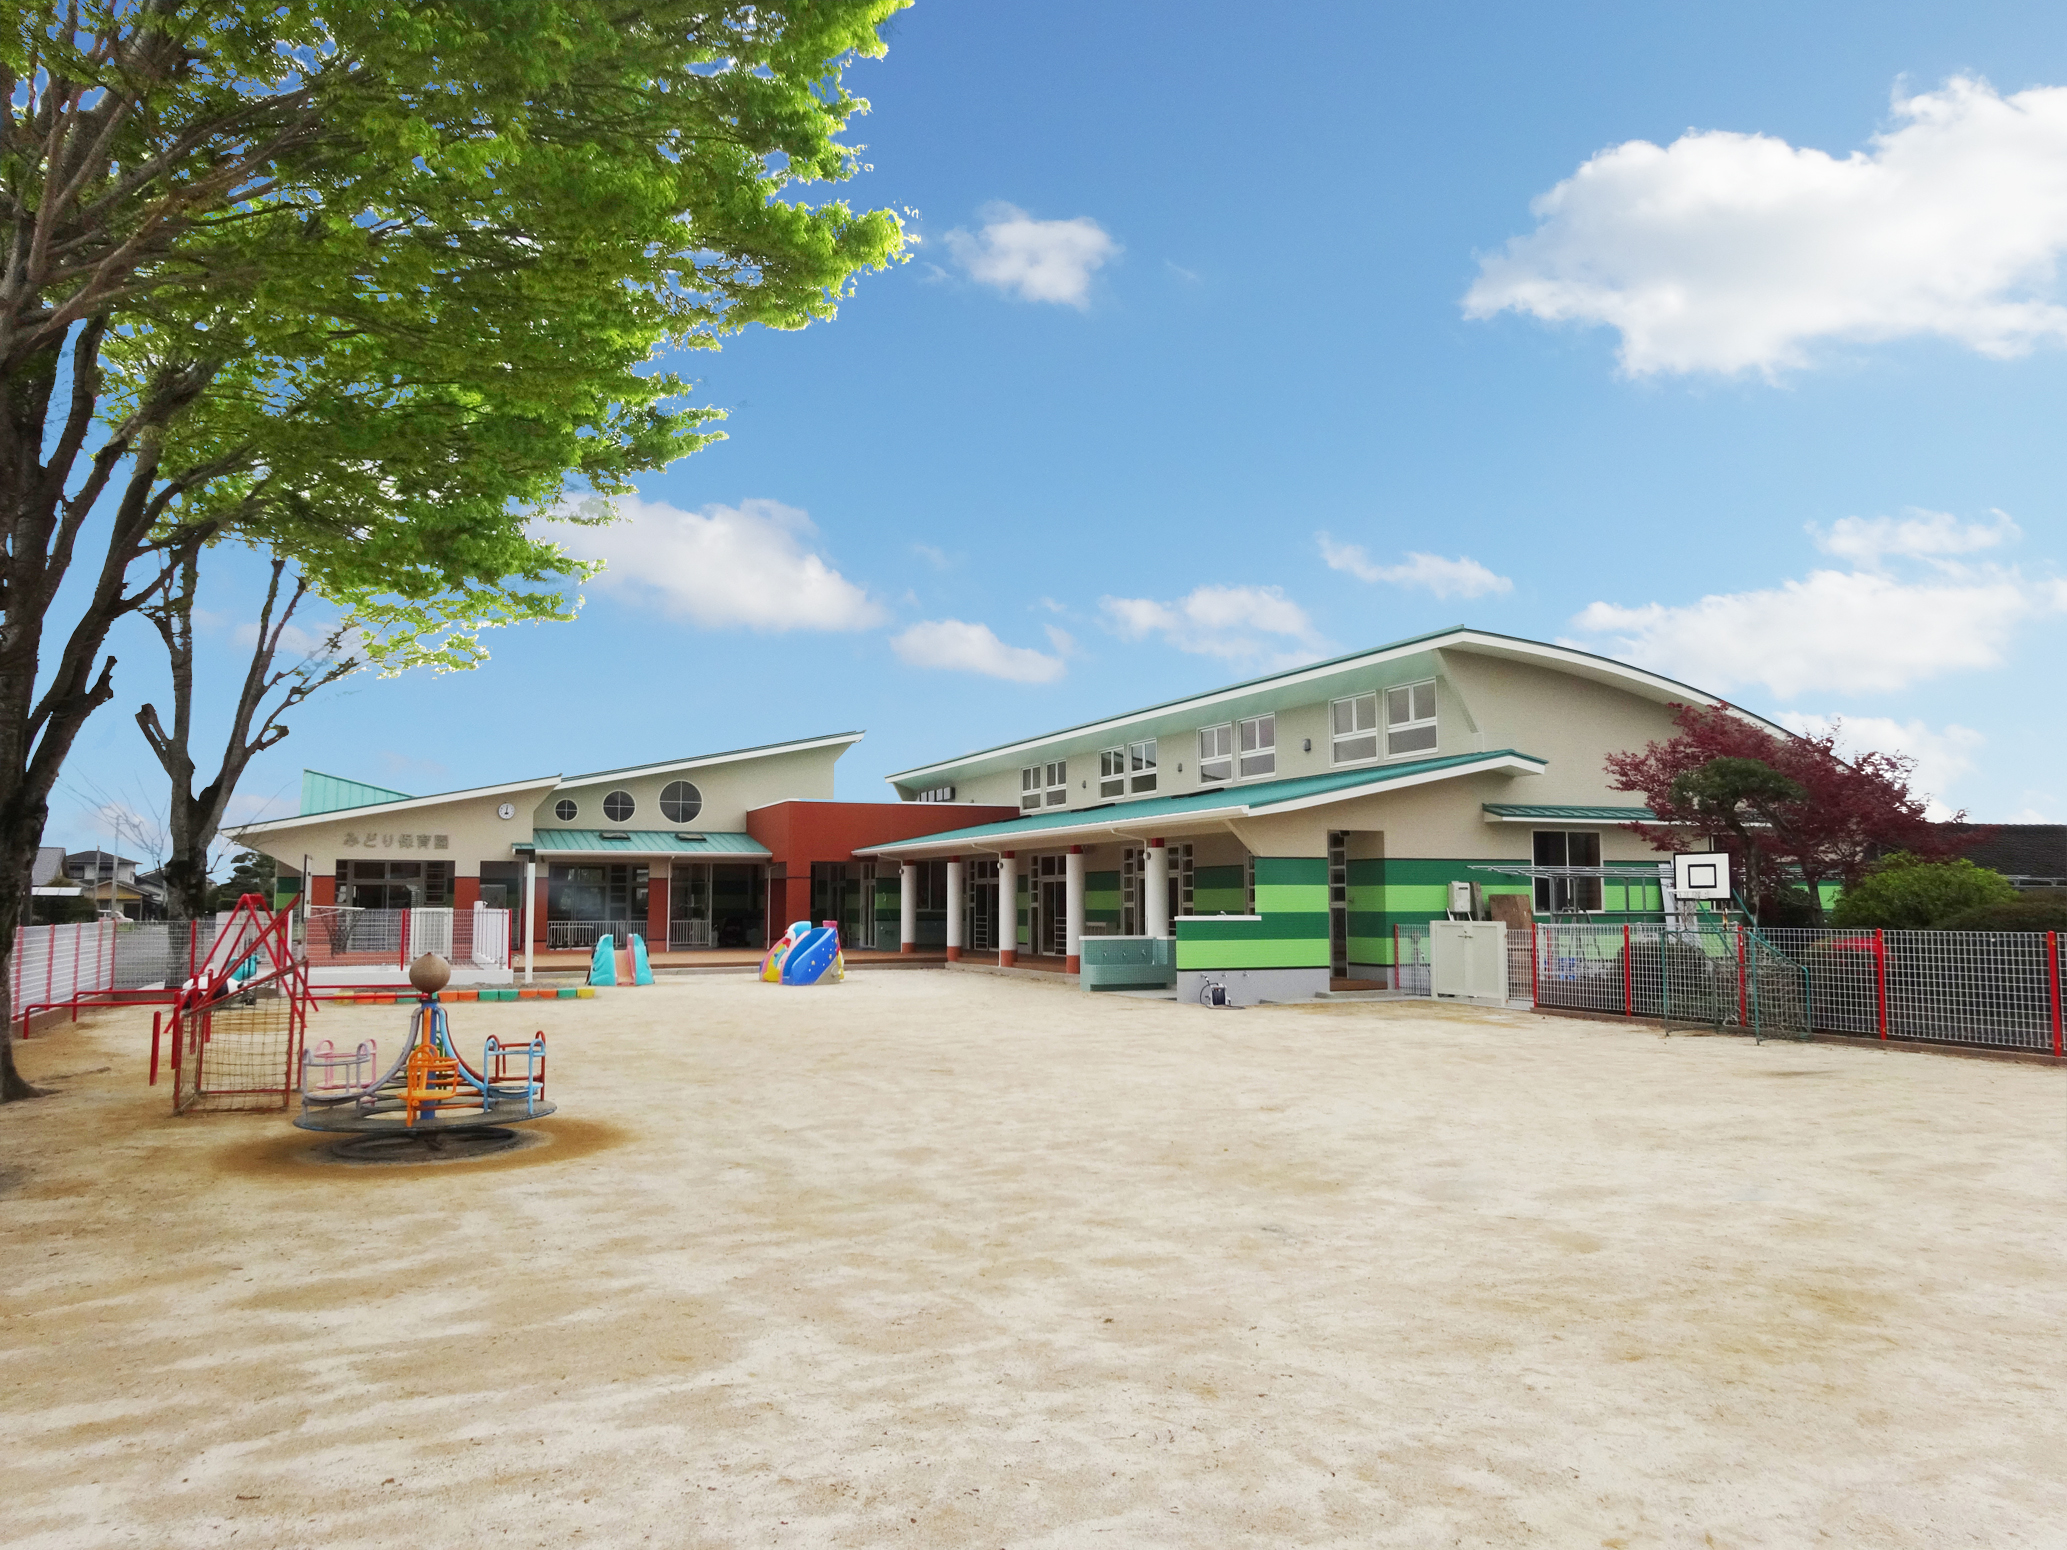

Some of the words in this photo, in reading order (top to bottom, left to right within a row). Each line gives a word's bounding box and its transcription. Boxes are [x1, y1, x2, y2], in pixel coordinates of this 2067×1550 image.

[343, 832, 449, 849] みどり保育園
